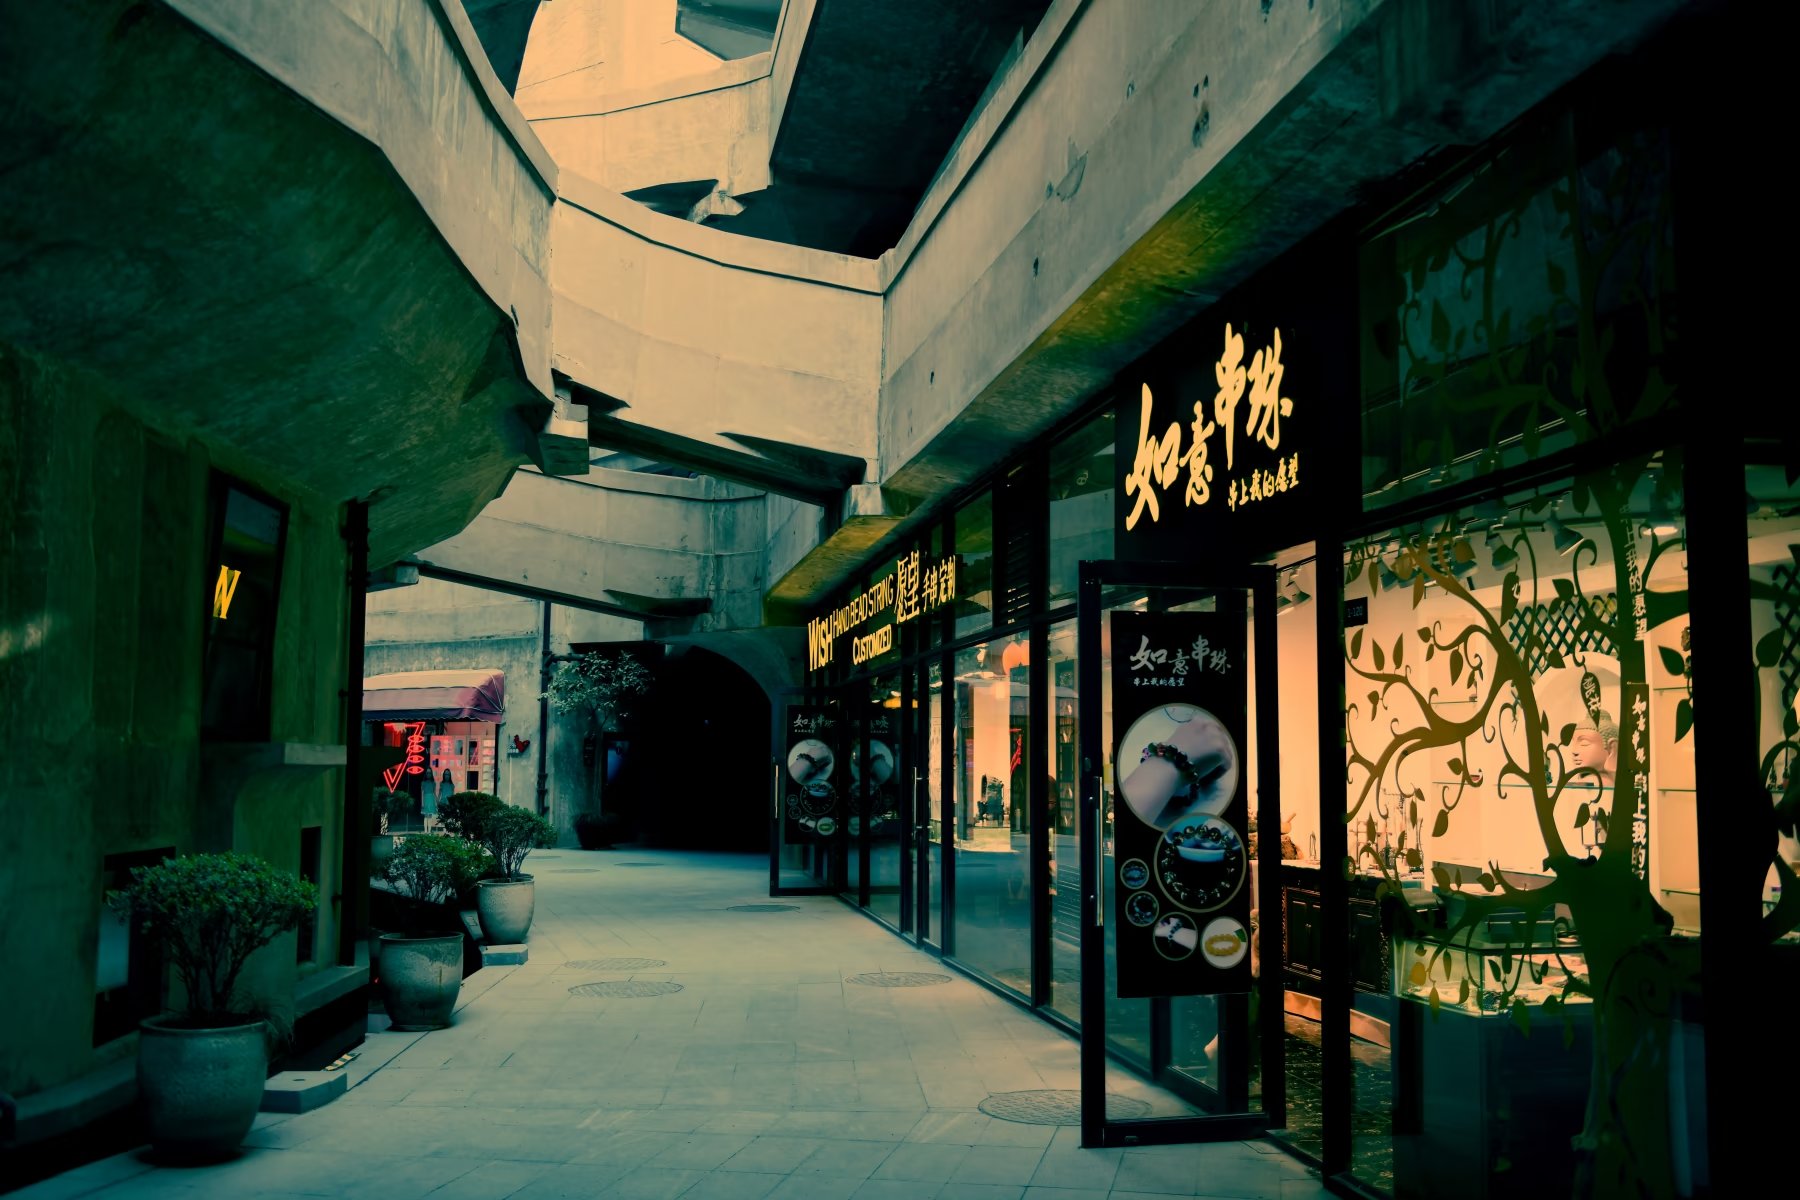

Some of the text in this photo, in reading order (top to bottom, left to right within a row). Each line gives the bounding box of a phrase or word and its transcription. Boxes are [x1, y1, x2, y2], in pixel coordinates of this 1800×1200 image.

[1125, 322, 1294, 532] 如意串珠
[833, 605, 850, 640] HAND
[850, 592, 868, 629] BEAD
[868, 573, 894, 618] STRING
[1129, 634, 1232, 675] 如意串珠
